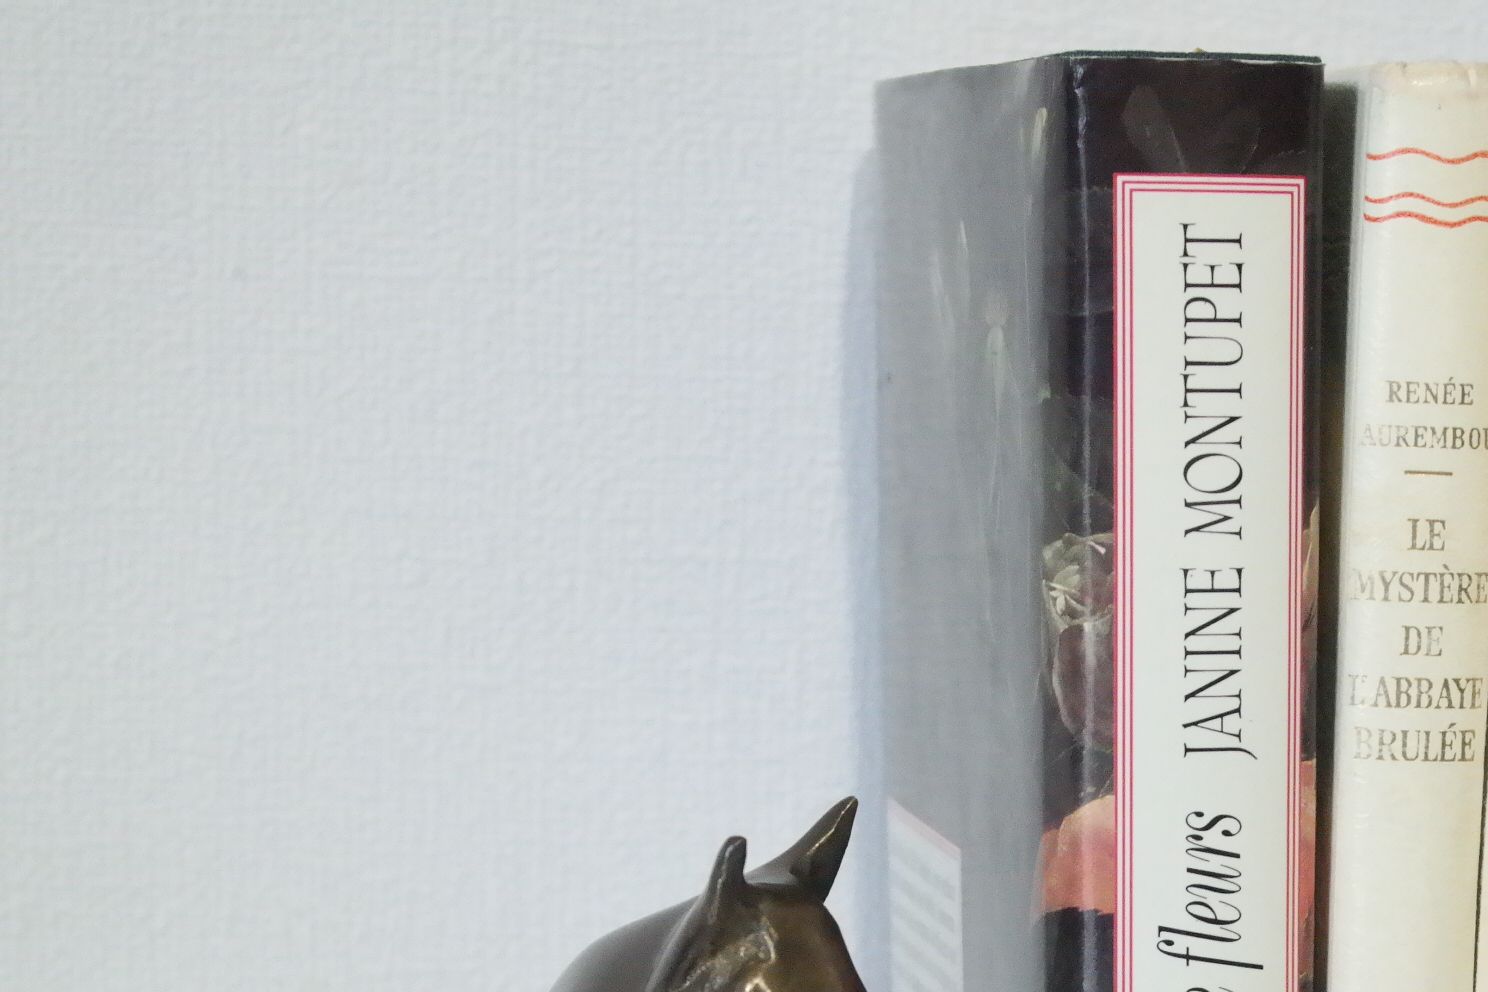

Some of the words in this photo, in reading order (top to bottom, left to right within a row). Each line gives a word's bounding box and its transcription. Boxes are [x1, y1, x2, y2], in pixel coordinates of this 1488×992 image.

[1181, 223, 1243, 539] MONTUPET
[1385, 377, 1474, 405] RENÉE
[1407, 519, 1446, 551] LE
[1350, 564, 1488, 604] MYSTÈRE
[1400, 625, 1443, 656] DE
[1182, 567, 1257, 758] JANINE
[1353, 723, 1476, 762] BRULÉE
[1157, 810, 1263, 969] fleurs
